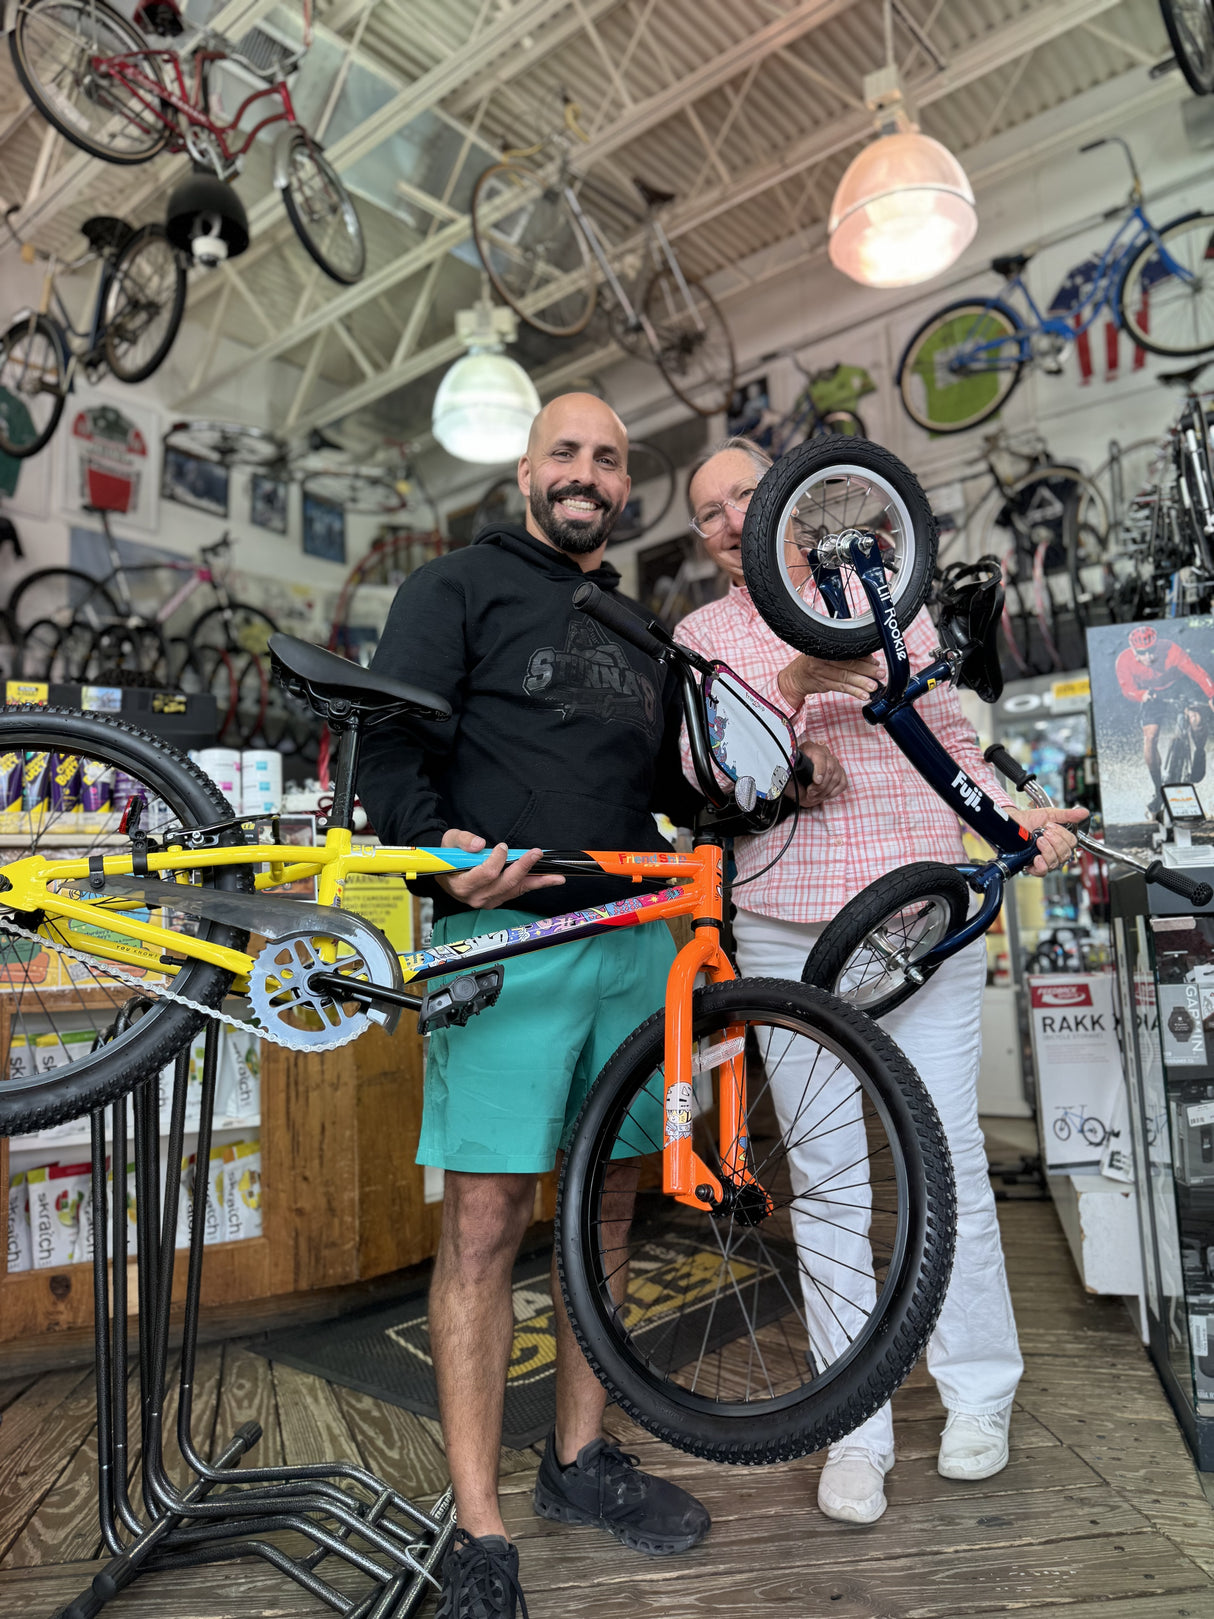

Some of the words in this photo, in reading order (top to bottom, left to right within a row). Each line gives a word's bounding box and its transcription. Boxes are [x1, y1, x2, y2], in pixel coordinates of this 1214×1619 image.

[618, 853, 657, 865] Friend
[658, 854, 687, 865] Ship
[1042, 1013, 1105, 1033] RAKK
[226, 1172, 243, 1235] skratch
[38, 1193, 55, 1260] skratch
